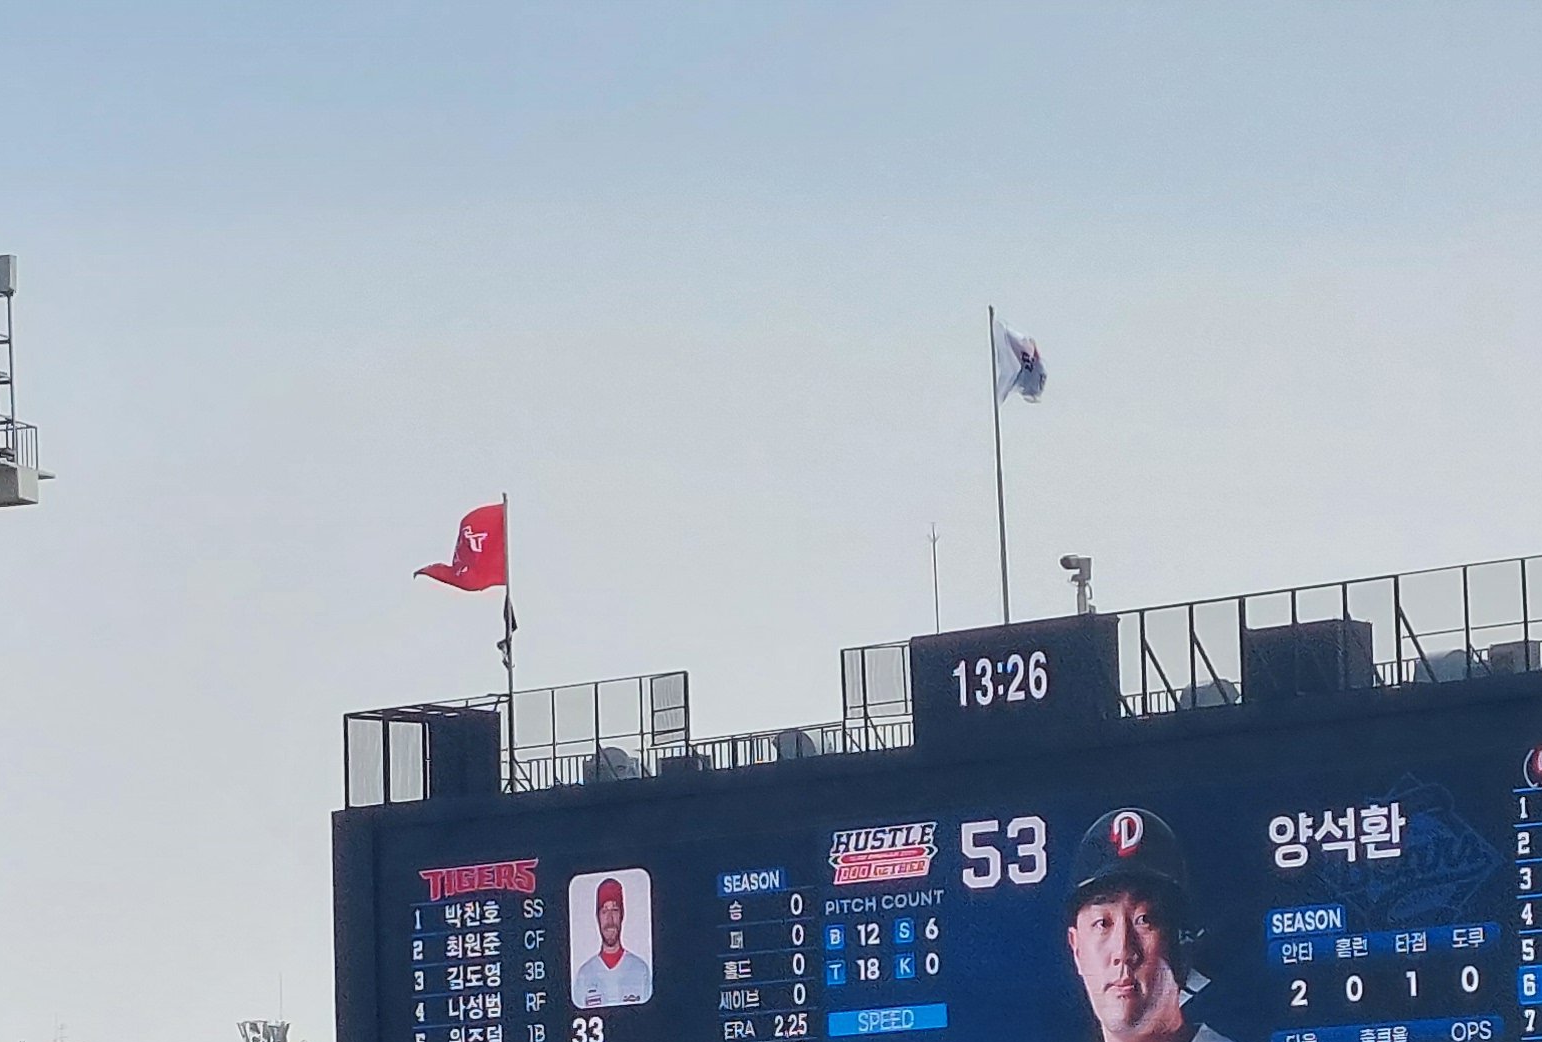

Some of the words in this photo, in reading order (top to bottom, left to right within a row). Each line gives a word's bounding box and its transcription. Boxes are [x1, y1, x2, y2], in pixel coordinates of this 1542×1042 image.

[953, 651, 1047, 706] 13:26
[833, 822, 936, 853] HUSTLE
[1269, 803, 1406, 868] 양석환
[961, 816, 1046, 888] 53
[421, 858, 539, 900] TIGERS
[723, 870, 779, 893] SEASON
[445, 901, 501, 928] 박찬호
[524, 899, 544, 918] SS
[729, 901, 742, 920] 승
[791, 894, 802, 915] 0
[825, 896, 876, 915] PITCH
[882, 889, 944, 909] COUNT
[857, 923, 880, 946] 12
[925, 918, 938, 939] 6
[1272, 908, 1343, 934] SEASON
[446, 932, 501, 958] 최원준
[525, 930, 545, 949] CF
[1282, 941, 1313, 963] 안타
[1336, 936, 1368, 957] 홈런
[1395, 933, 1427, 954] 타점
[1452, 927, 1485, 947] 도루
[447, 962, 501, 990] 김도영
[524, 962, 545, 981] 3B
[724, 959, 751, 979] 홀드
[793, 953, 804, 975] 0
[856, 958, 880, 980] 18
[926, 953, 939, 974] 0
[719, 989, 759, 1010] 세이브
[794, 983, 805, 1004] 0
[1291, 980, 1308, 1006] 2
[1346, 976, 1362, 1001] 0
[1406, 971, 1416, 996] 1
[1461, 966, 1478, 992] 0
[449, 992, 501, 1020] 나성범
[526, 992, 546, 1012] RF
[527, 1024, 545, 1042] 1B
[724, 1020, 755, 1040] ERA
[775, 1013, 807, 1038] 2.25
[858, 1010, 914, 1032] SPEED
[1451, 1020, 1491, 1041] OPS
